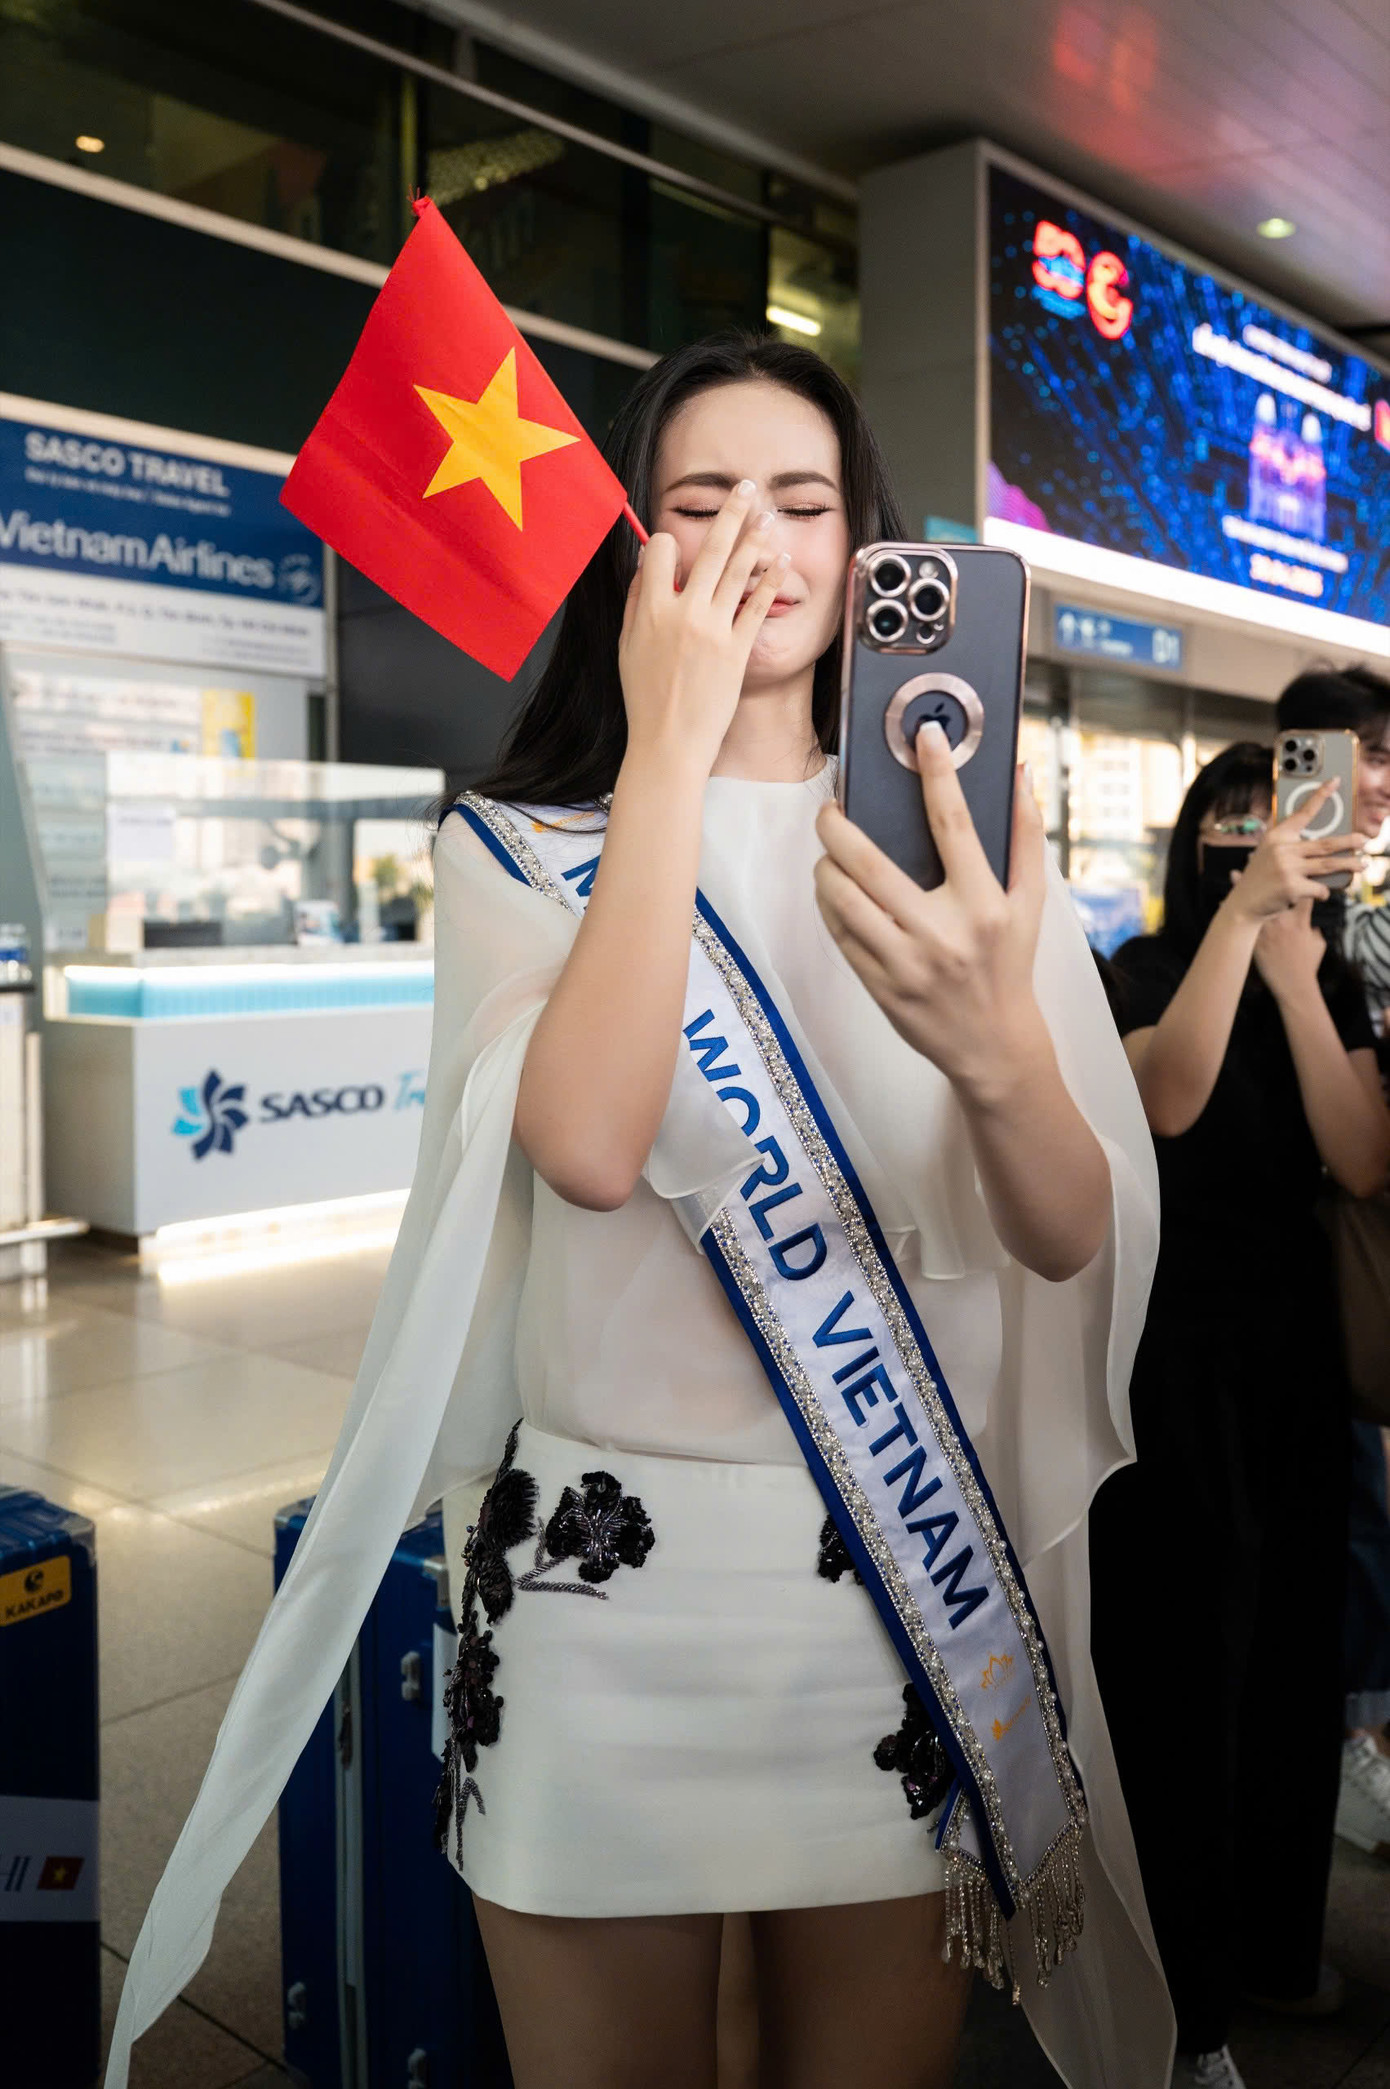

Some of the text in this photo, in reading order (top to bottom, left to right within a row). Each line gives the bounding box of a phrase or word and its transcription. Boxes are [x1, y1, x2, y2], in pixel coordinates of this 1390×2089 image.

[24, 431, 127, 477] SASCO
[128, 452, 231, 498] TRAVEL
[259, 1083, 386, 1124] SASCO
[812, 1290, 990, 1631] VIETNAM
